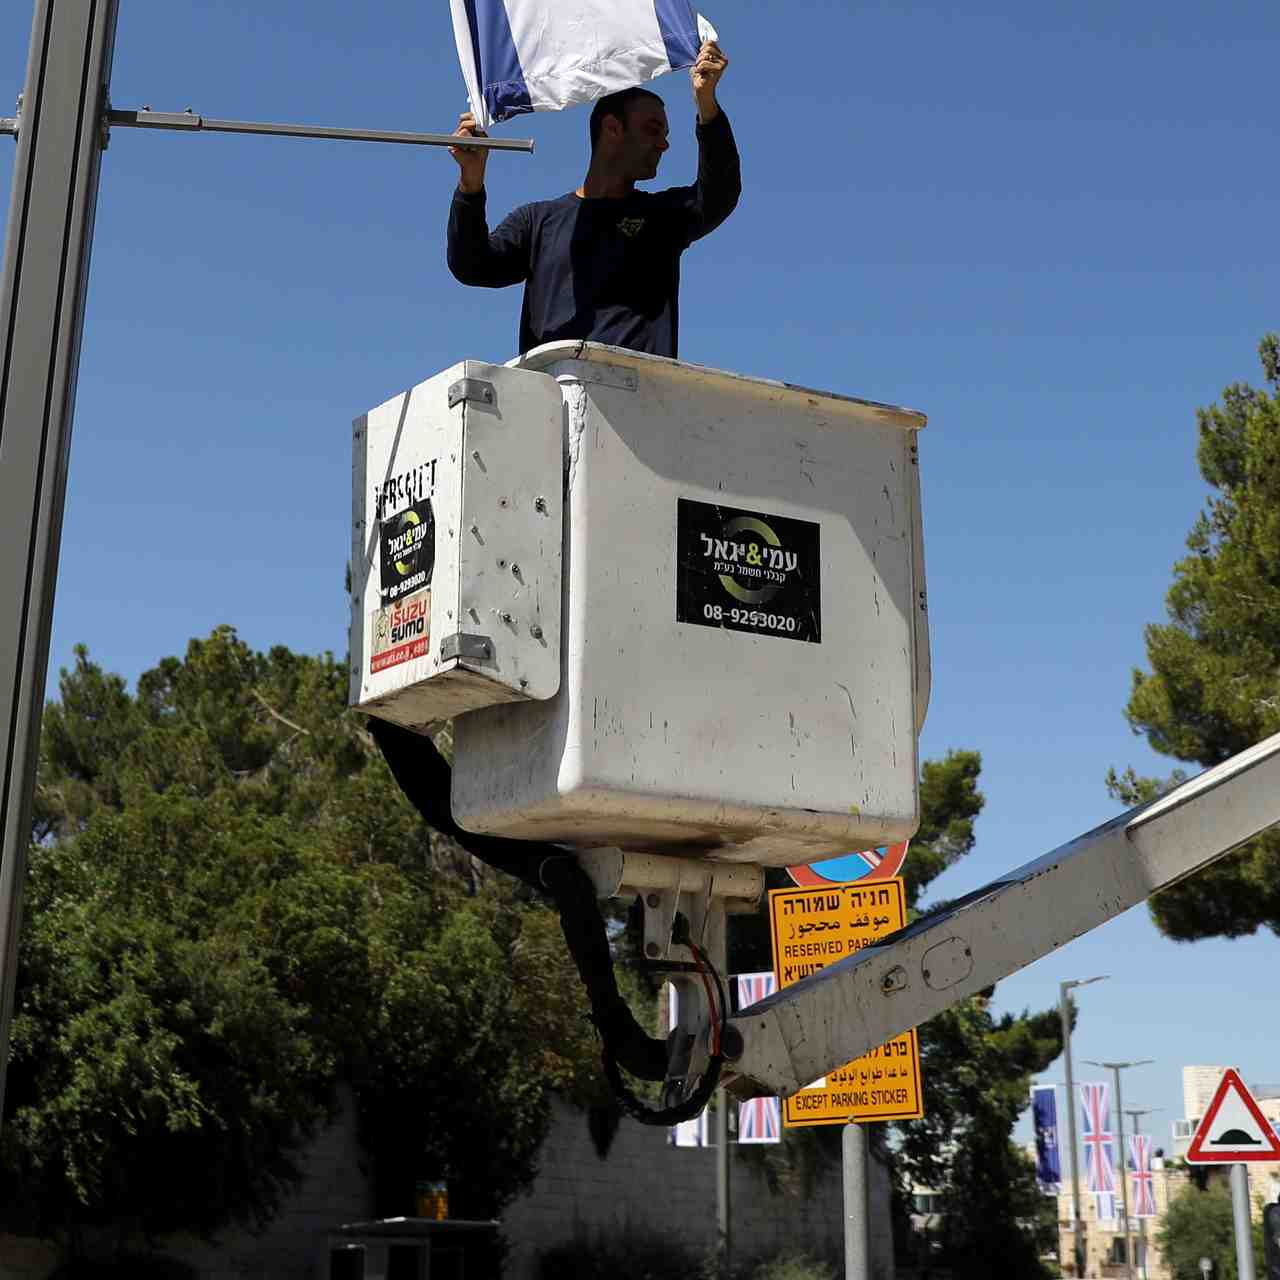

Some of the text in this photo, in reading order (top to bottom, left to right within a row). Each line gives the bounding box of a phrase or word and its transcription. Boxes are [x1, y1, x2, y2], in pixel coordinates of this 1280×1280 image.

[390, 599, 427, 628] ISUZU
[703, 603, 796, 632] 08-9293020
[783, 889, 890, 916] חניה שמורה
[849, 913, 890, 932] موقف
[784, 940, 843, 959] RESERVED
[883, 1041, 908, 1057] פרט
[795, 1088, 909, 1111] EXCEPT PARKING STICKER
